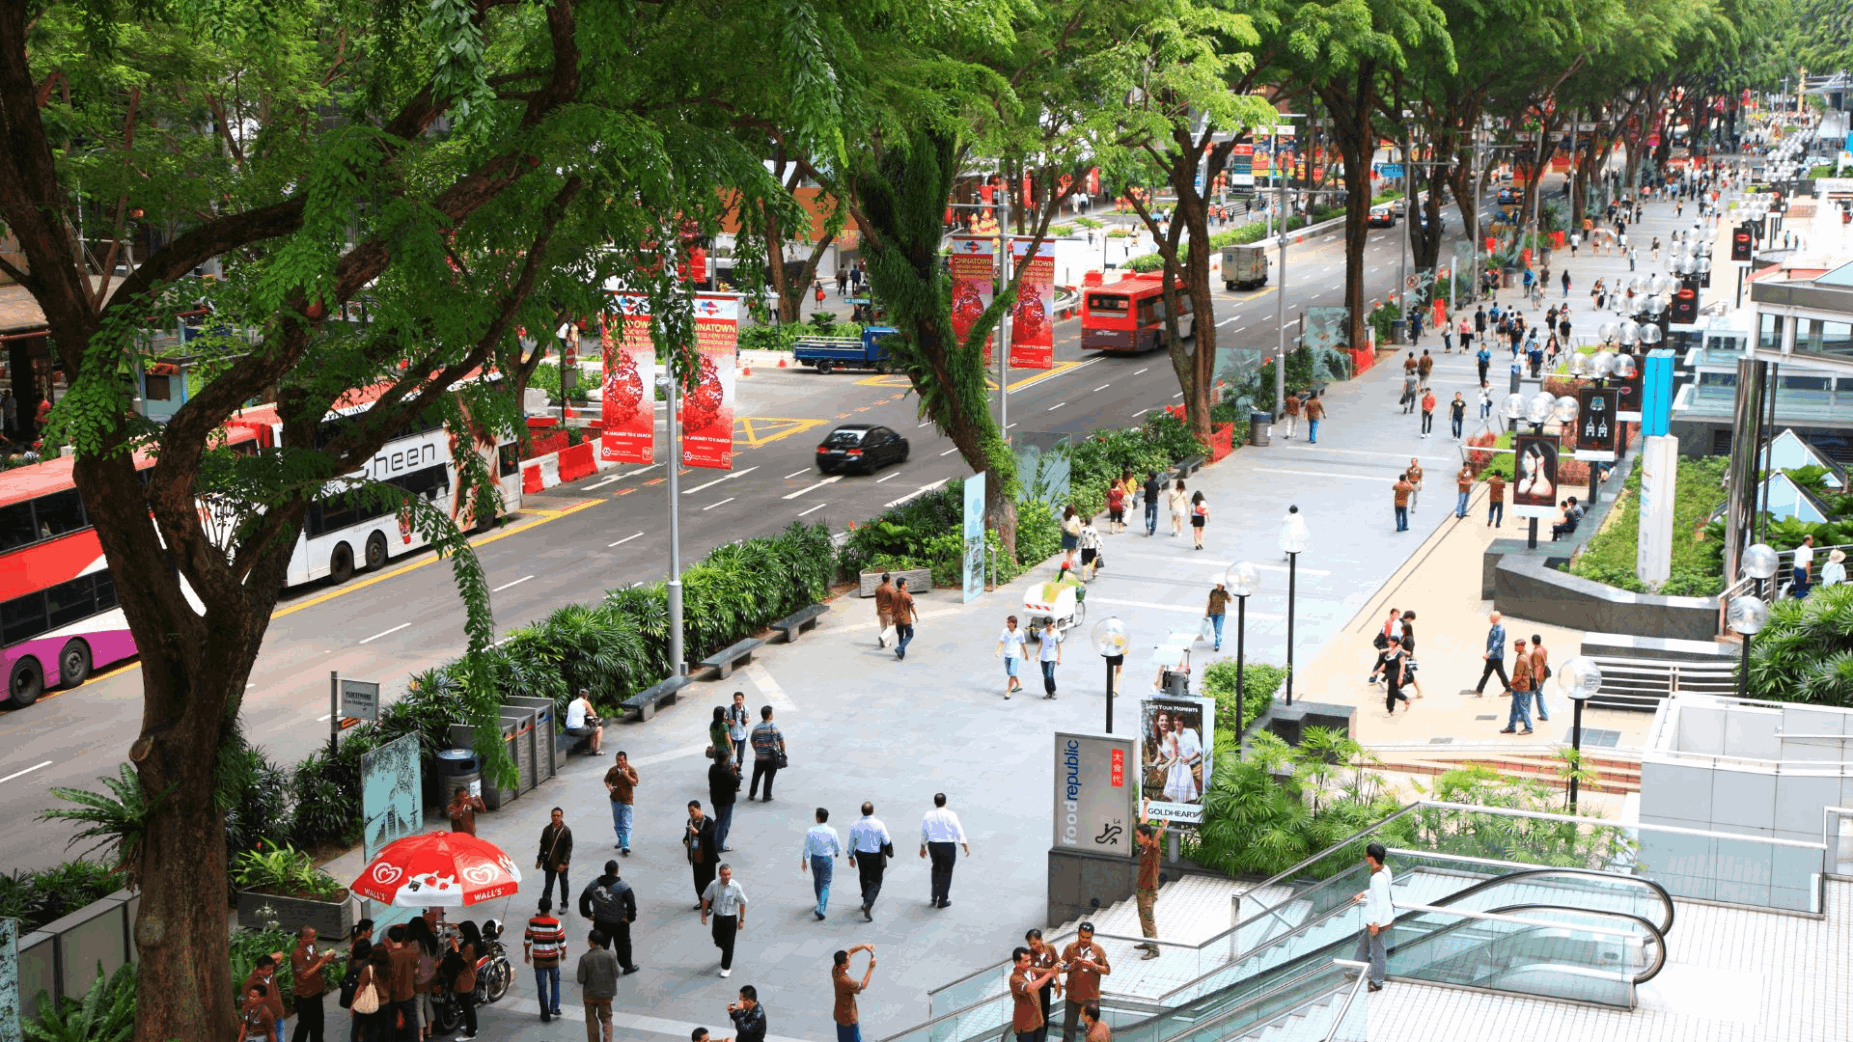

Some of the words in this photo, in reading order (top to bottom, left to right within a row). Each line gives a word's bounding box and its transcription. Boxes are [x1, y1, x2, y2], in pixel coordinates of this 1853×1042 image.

[954, 257, 992, 265] CHINATOWN
[1015, 259, 1054, 267] CATOWN
[694, 323, 736, 333] INATOWN
[1147, 807, 1199, 819] GOLDHEART
[364, 887, 388, 901] WALL'S
[474, 887, 503, 902] WALL'S
